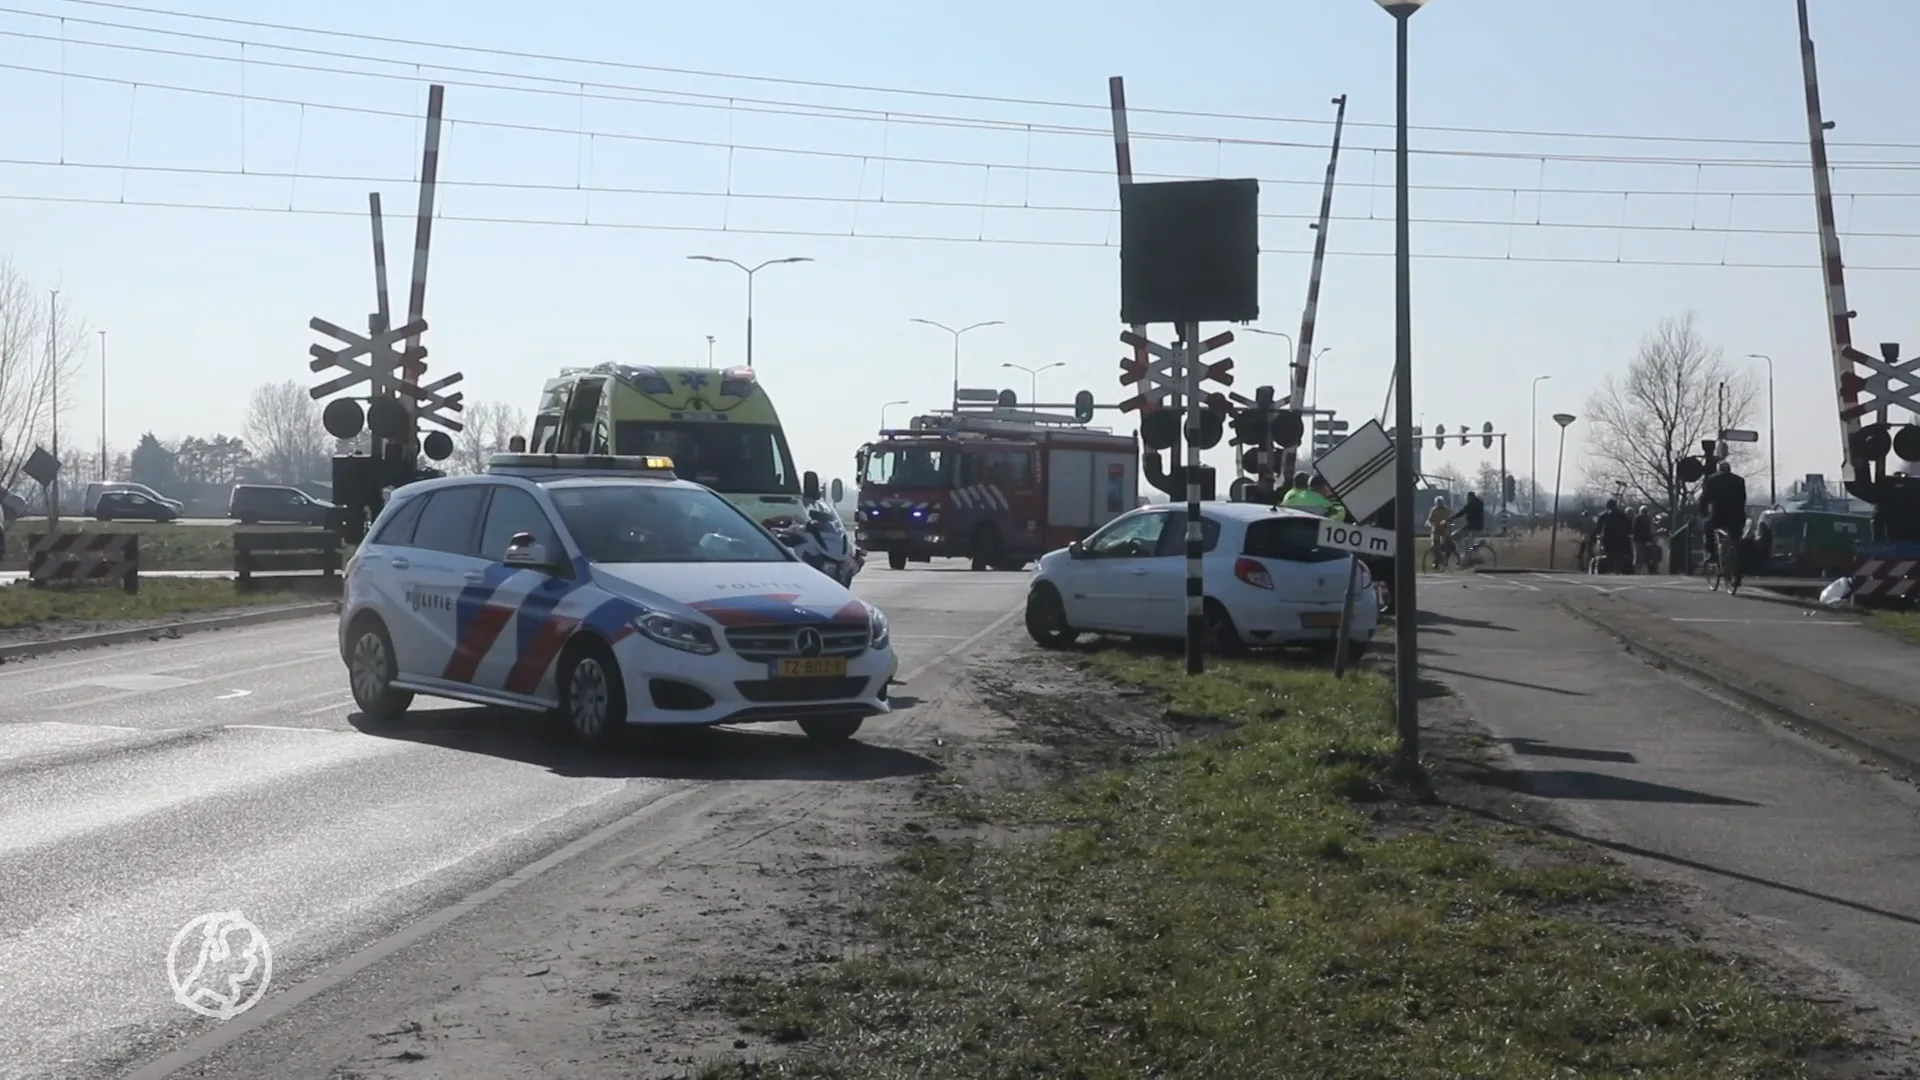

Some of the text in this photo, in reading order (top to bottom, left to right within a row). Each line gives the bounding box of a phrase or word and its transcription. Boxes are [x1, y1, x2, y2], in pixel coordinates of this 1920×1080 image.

[1326, 526, 1388, 551] 100 m
[716, 582, 803, 590] POLITIE
